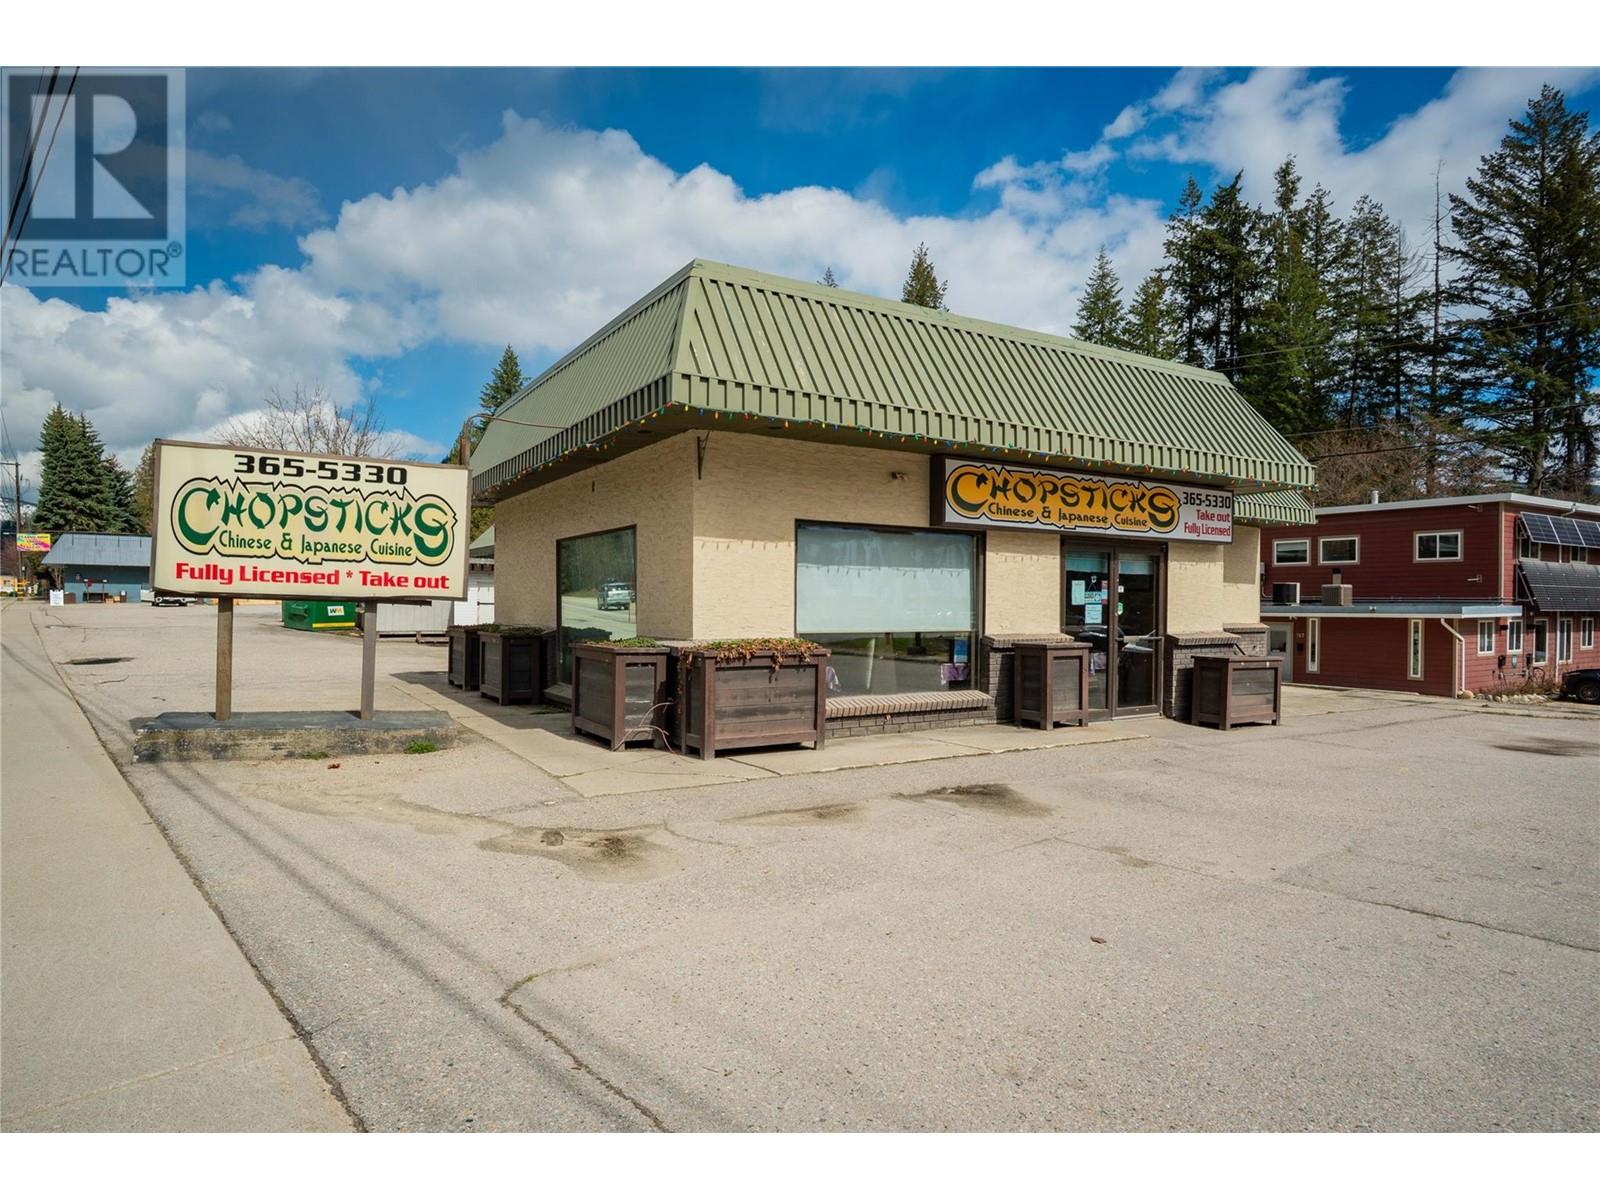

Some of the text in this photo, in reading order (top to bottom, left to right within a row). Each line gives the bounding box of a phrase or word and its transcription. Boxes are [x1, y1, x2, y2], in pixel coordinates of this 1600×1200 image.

[234, 454, 407, 485] 365-5330
[951, 472, 1175, 527] CHOPSTICKS
[1182, 492, 1231, 509] 365-5330
[178, 487, 449, 558] CHOPSTICKS
[988, 502, 1148, 527] Chinese & Japanese Cuisine
[1196, 509, 1230, 523] Take out
[1184, 522, 1231, 537] Fully Licensed
[219, 530, 413, 557] Chinese & Japanese Cuisine
[176, 562, 233, 585] Fully
[239, 565, 340, 585] Licensed
[359, 570, 409, 588] Take
[414, 575, 449, 589] out
